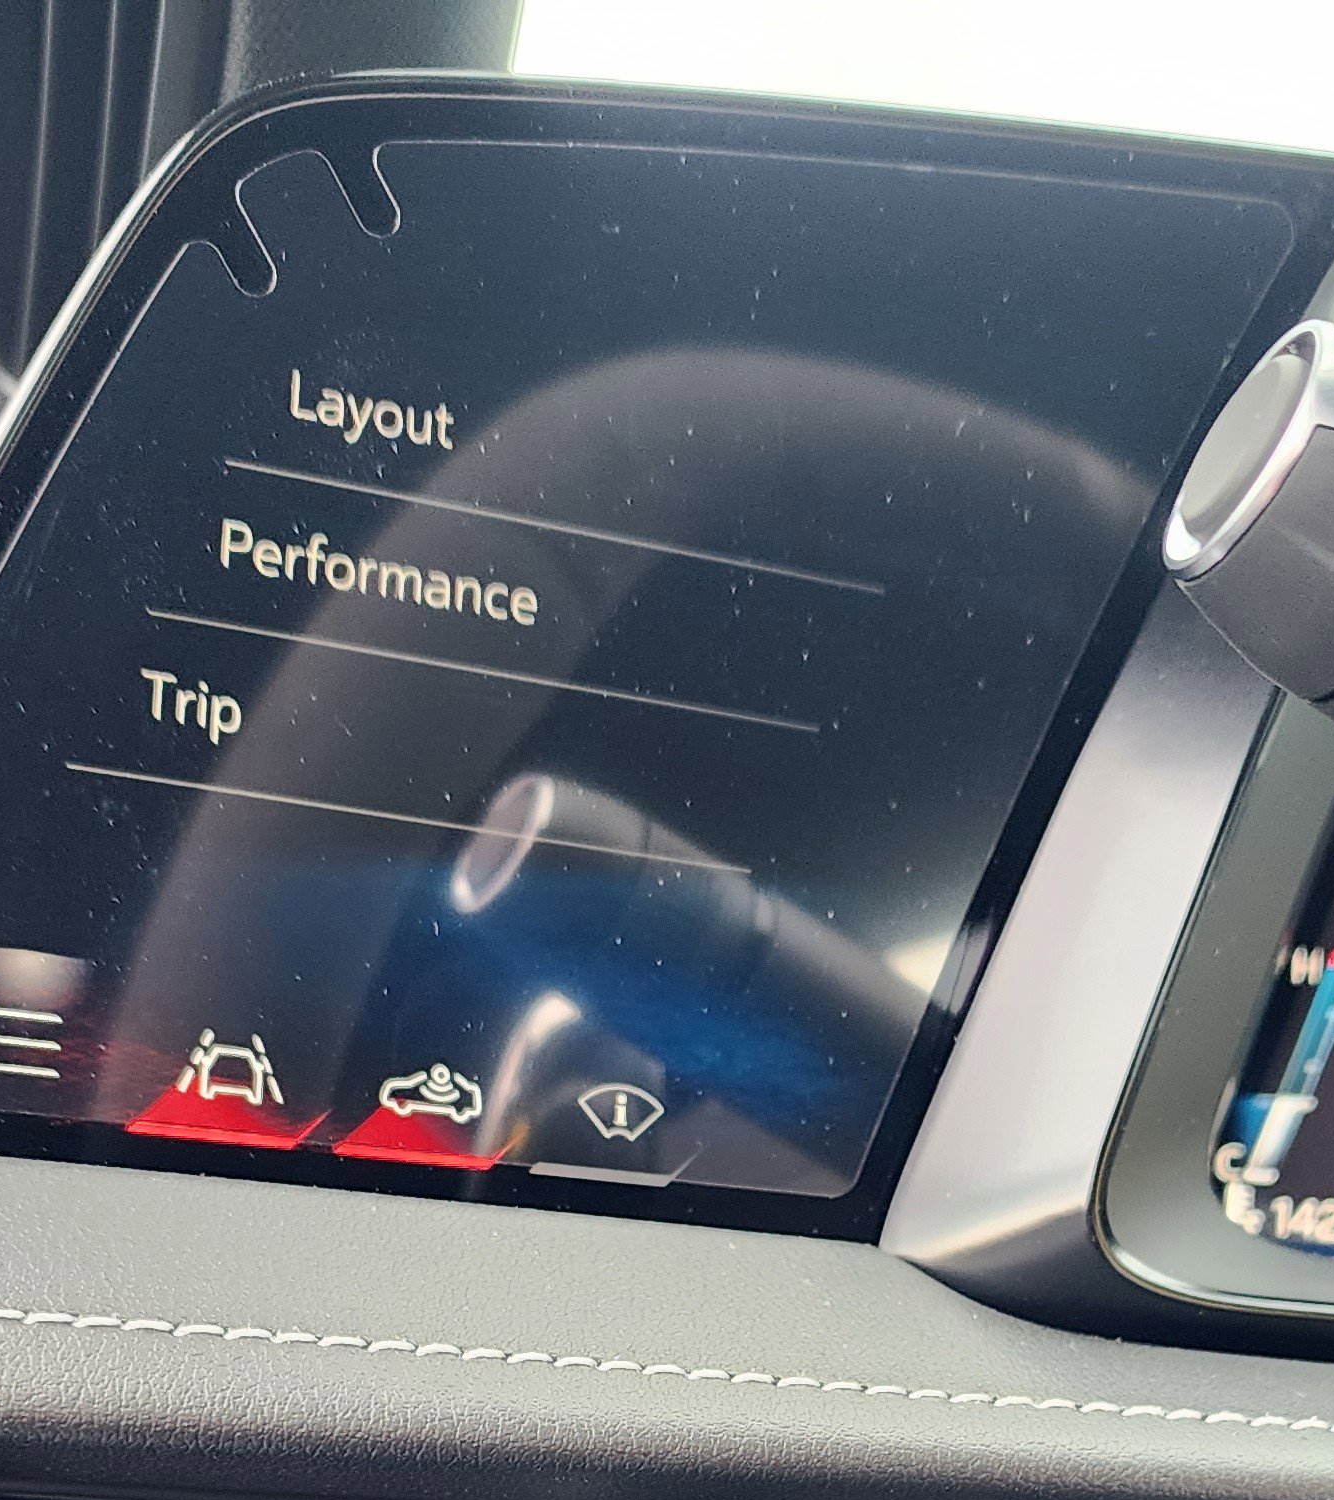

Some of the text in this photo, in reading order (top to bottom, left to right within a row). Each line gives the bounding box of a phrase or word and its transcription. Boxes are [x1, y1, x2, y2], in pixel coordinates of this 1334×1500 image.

[288, 368, 456, 450] Layout
[218, 518, 539, 626] Performance
[140, 667, 242, 744] Trip
